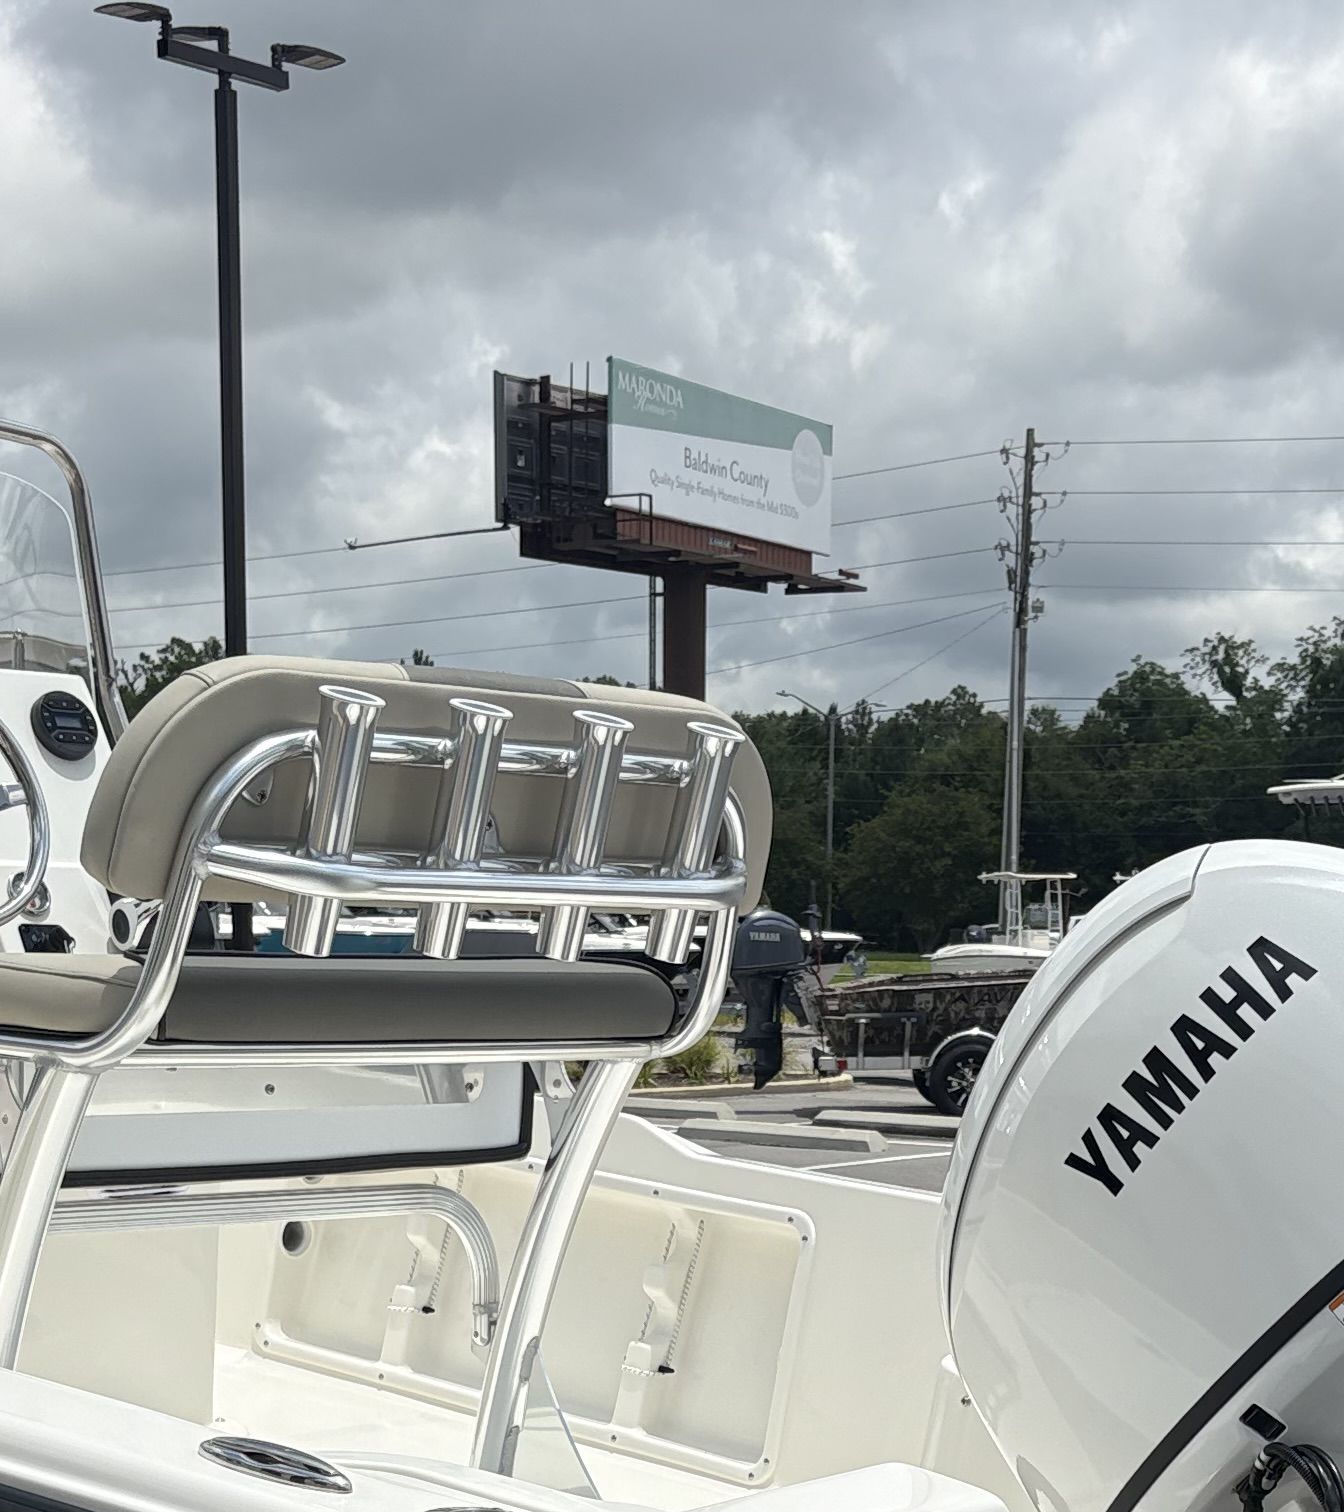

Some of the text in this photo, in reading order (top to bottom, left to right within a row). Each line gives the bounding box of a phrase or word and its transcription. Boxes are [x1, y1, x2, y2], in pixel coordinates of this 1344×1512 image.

[617, 369, 684, 409] MARONDA
[649, 468, 675, 492] Quality
[717, 489, 740, 505] Homes
[683, 446, 728, 479] Baldwin
[729, 459, 770, 498] County
[749, 931, 781, 942] YAMAHA
[1063, 935, 1319, 1198] YAMAHA
